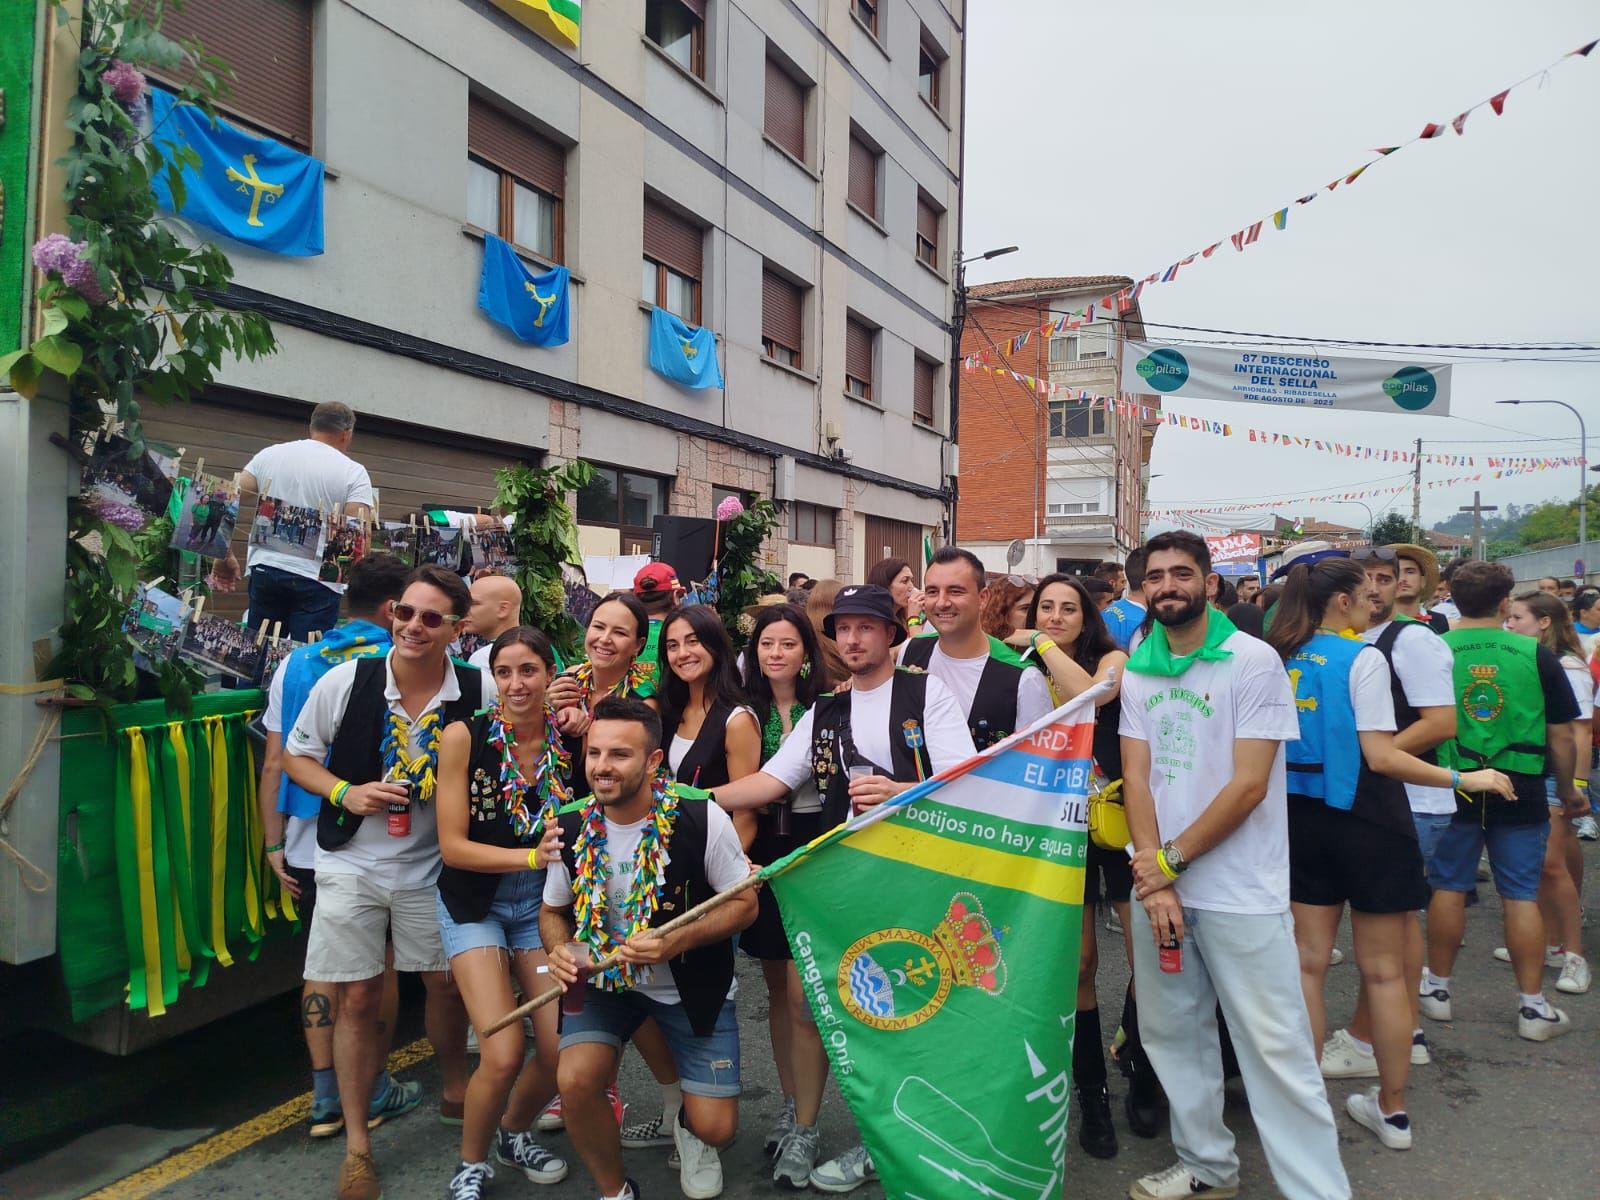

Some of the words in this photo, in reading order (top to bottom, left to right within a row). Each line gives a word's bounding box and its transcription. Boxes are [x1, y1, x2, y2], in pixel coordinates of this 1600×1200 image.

[1242, 354, 1258, 363] 87
[1261, 355, 1330, 368] DESCENSO
[1136, 363, 1182, 376] ecopilas
[1234, 363, 1338, 379] INTERNACIONAL
[1251, 375, 1275, 386] DEL
[1279, 377, 1318, 389] SELLA
[1382, 381, 1429, 393] ecopilas
[1232, 385, 1277, 394] ARRIONDAS
[1284, 389, 1337, 398] RIBADESELLA
[1261, 395, 1294, 403] AGOSTO
[1313, 398, 1334, 406] 2025
[1453, 643, 1481, 653] ANGAS
[1024, 762, 1049, 786] EL
[905, 804, 967, 834] botijos
[971, 823, 996, 840] no
[1001, 825, 1035, 852] hay
[1039, 837, 1072, 858] agua
[878, 929, 944, 961] MAXIMA
